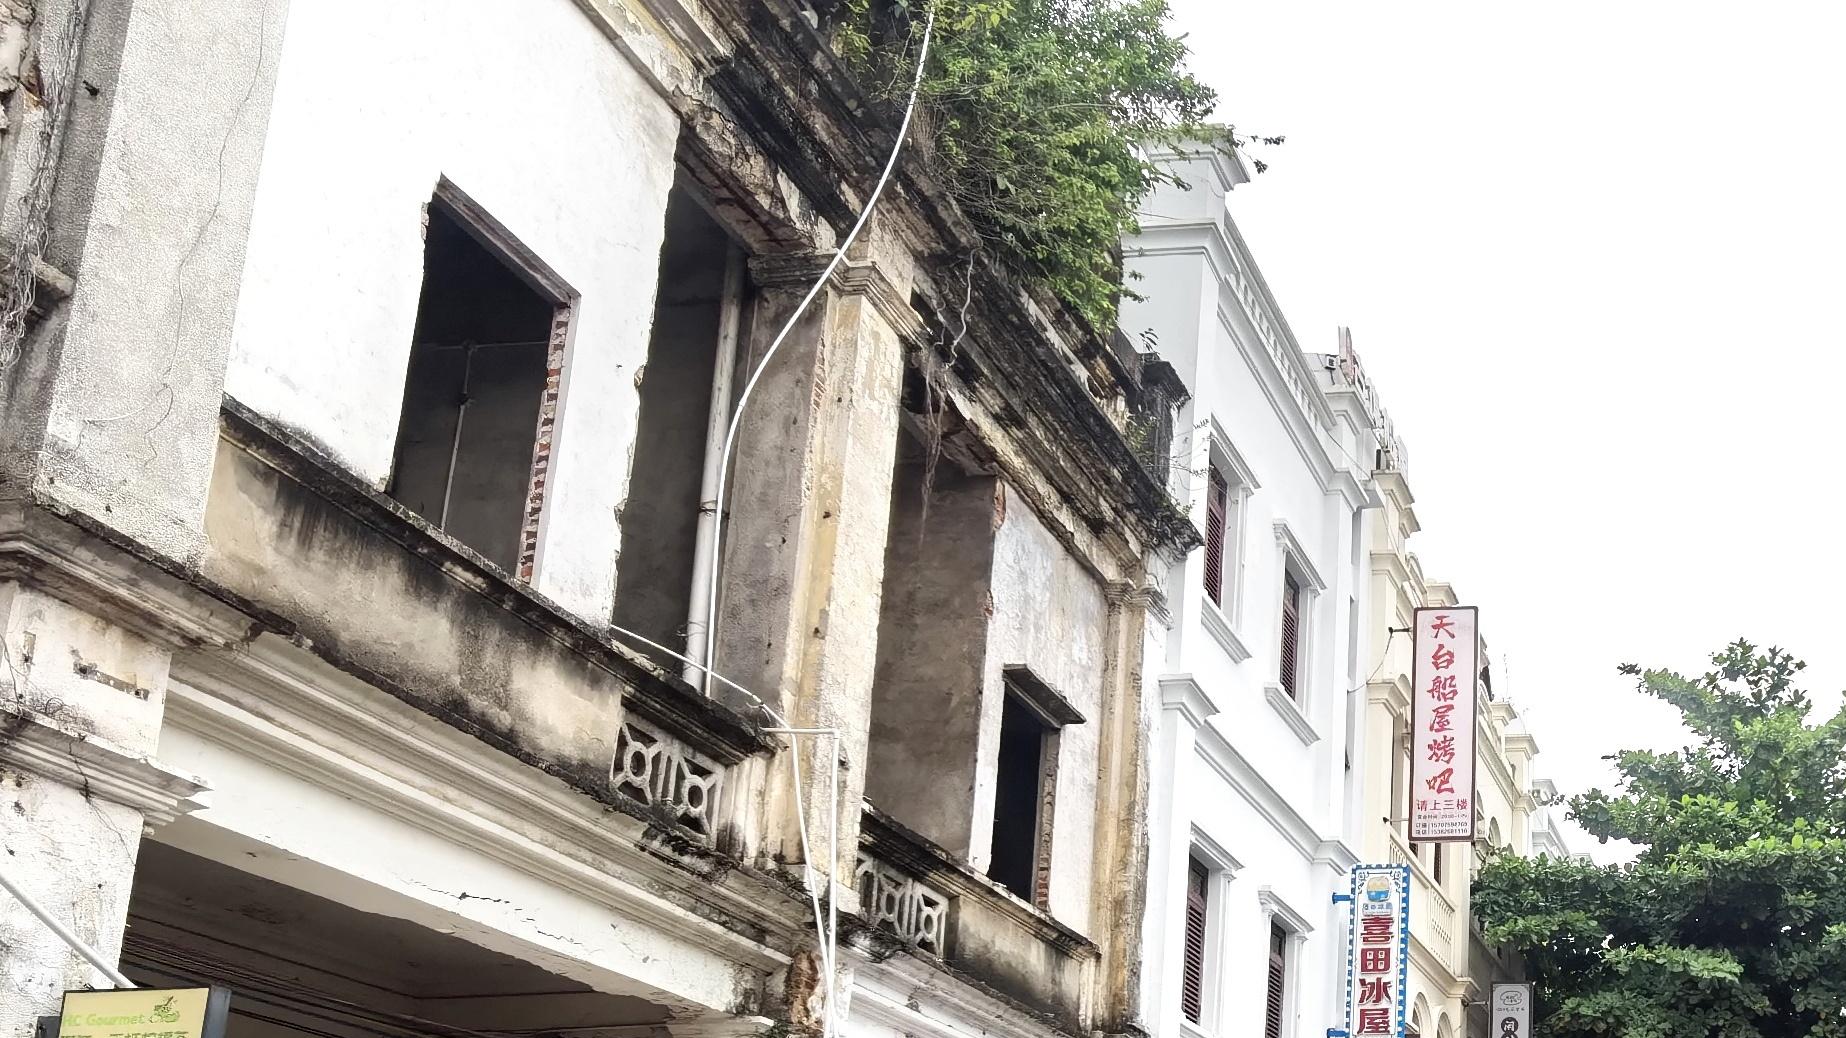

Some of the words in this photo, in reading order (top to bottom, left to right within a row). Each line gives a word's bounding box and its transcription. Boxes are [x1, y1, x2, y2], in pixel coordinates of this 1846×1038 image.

[1426, 615, 1458, 794] 天台船屋烤吧
[1417, 799, 1467, 811] 请上三楼
[1357, 916, 1394, 1035] 喜田冰屋
[86, 1013, 146, 1026] Gourmet
